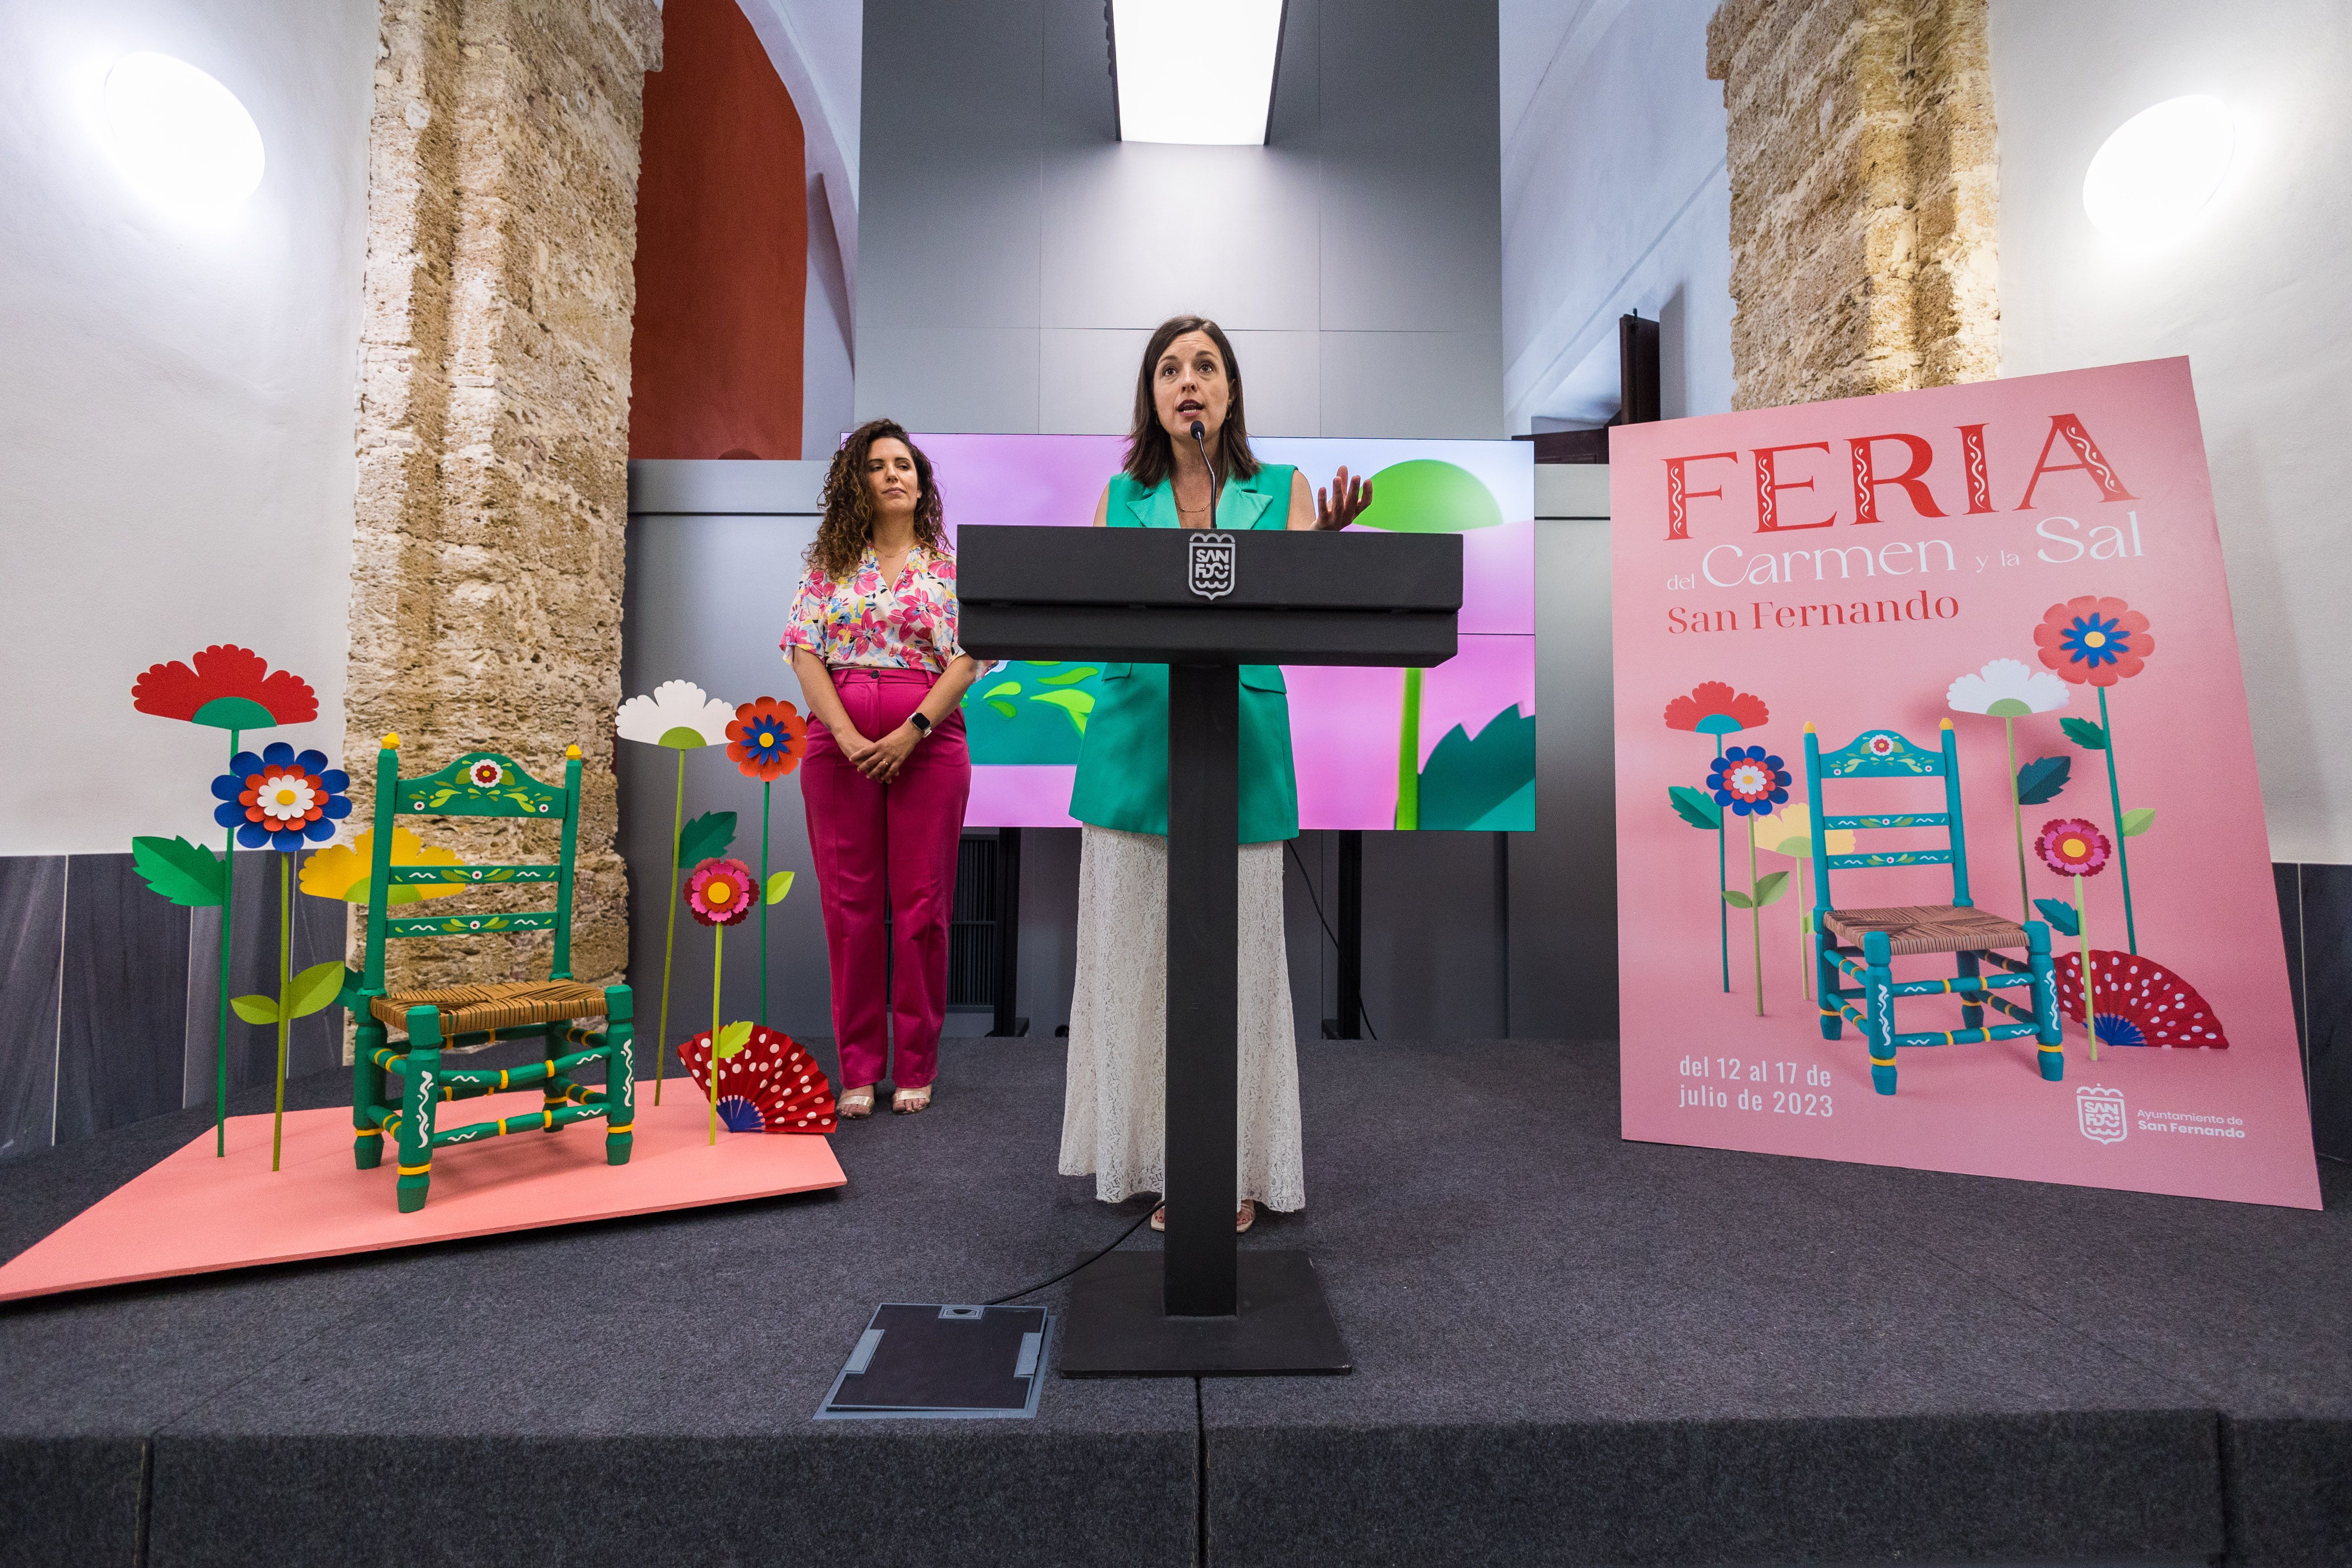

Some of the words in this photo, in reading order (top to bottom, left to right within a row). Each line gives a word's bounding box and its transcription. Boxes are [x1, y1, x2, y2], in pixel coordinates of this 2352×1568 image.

[1660, 413, 2141, 541] FERIA
[1196, 549, 1229, 563] SAN
[1667, 574, 1696, 590] del
[1702, 539, 1957, 587] Carmen
[1976, 555, 1989, 574] y
[2001, 549, 2021, 567] la
[2036, 511, 2145, 563] Sal
[1668, 607, 1740, 634] San
[1750, 590, 1960, 630] Fernando
[1679, 1055, 1709, 1077] del
[1717, 1057, 1741, 1080] 12
[1750, 1060, 1767, 1082] al
[1775, 1061, 1797, 1084] 17
[1807, 1065, 1831, 1087] de
[1679, 1085, 1727, 1108] julio
[1738, 1089, 1762, 1111] de
[1773, 1091, 1833, 1117] 2023
[2084, 1102, 2118, 1114] SAN
[2137, 1110, 2224, 1125] Ayuntamiento
[2227, 1116, 2243, 1126] de
[2138, 1120, 2167, 1132] San
[2170, 1123, 2245, 1139] Fernando
